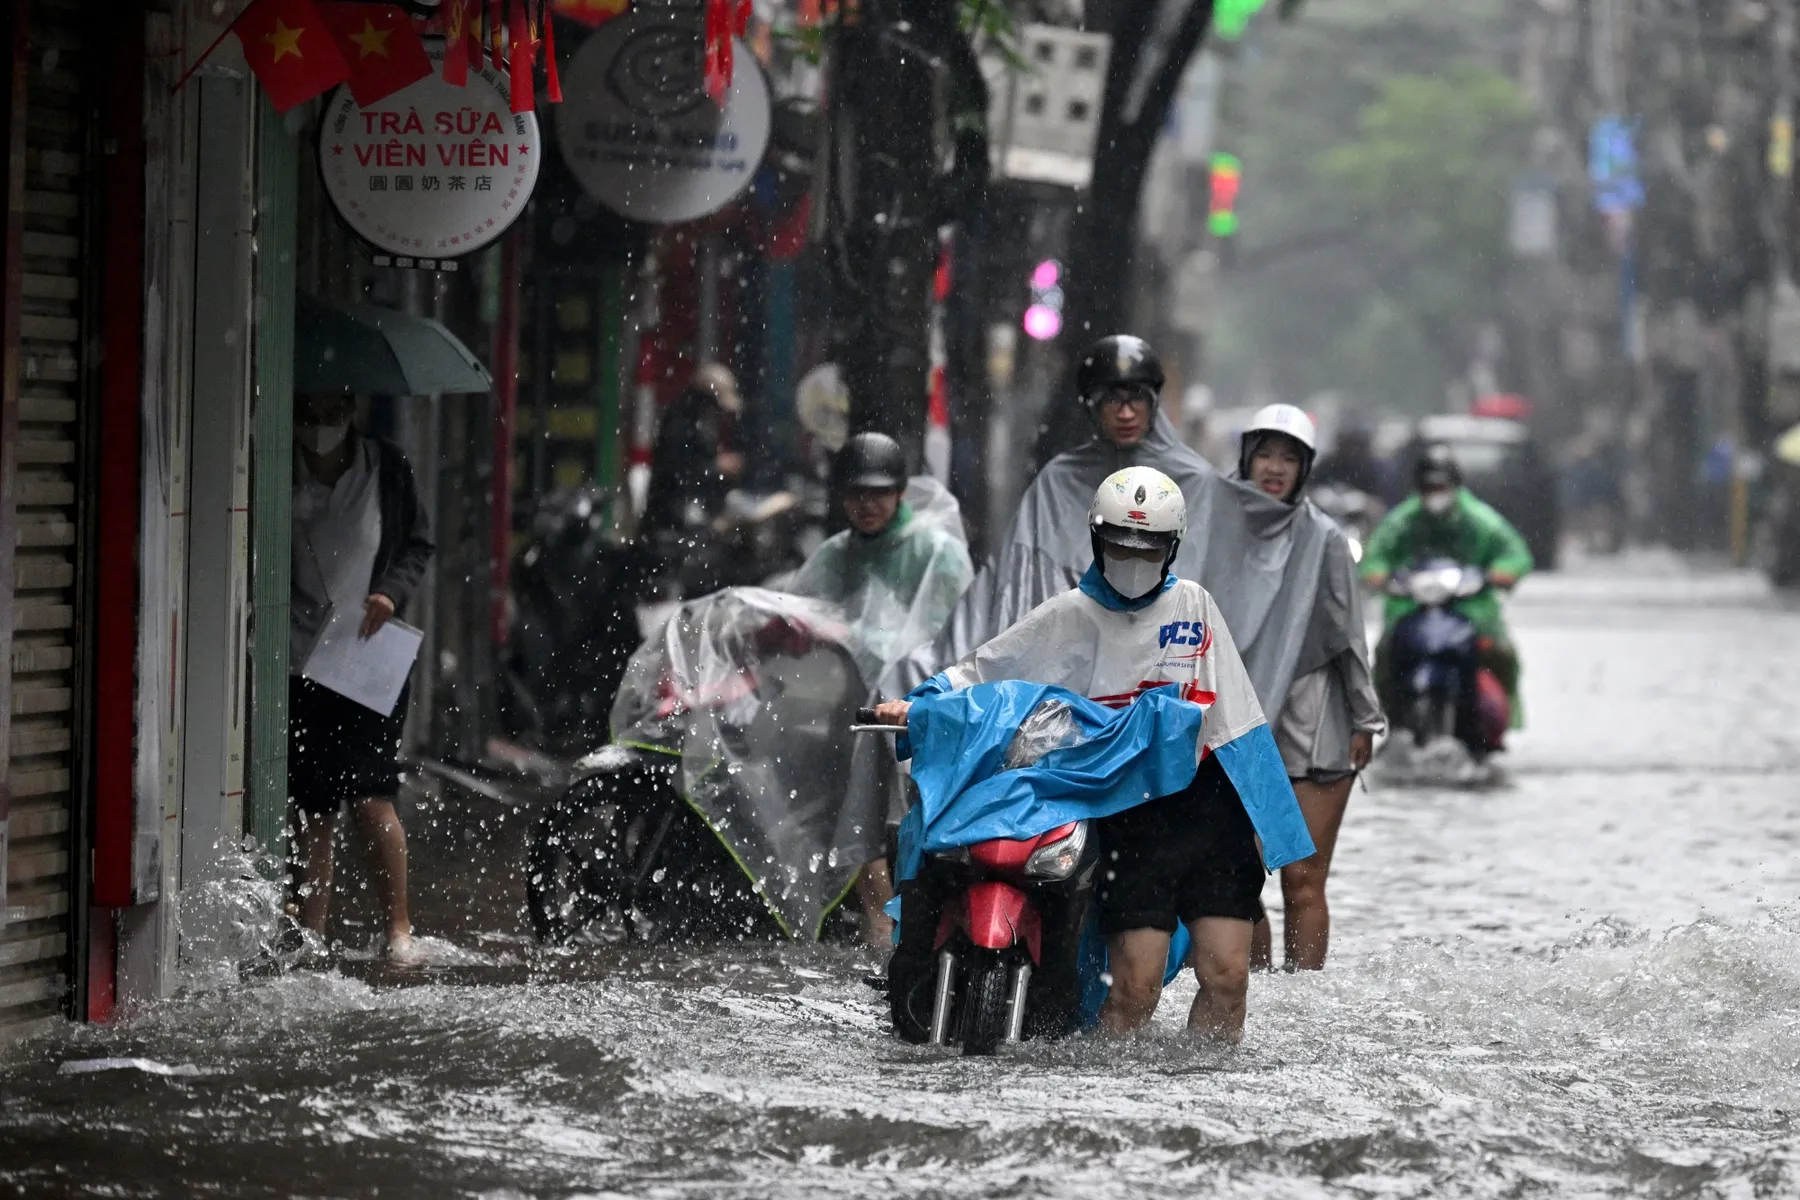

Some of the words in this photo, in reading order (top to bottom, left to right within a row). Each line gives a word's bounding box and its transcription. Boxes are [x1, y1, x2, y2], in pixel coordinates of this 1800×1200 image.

[360, 107, 424, 135] TRÀ
[435, 107, 504, 135] SỮA
[353, 139, 426, 167] VIÊN
[436, 138, 509, 167] VIÊN
[369, 175, 493, 192] 圓圓奶茶店
